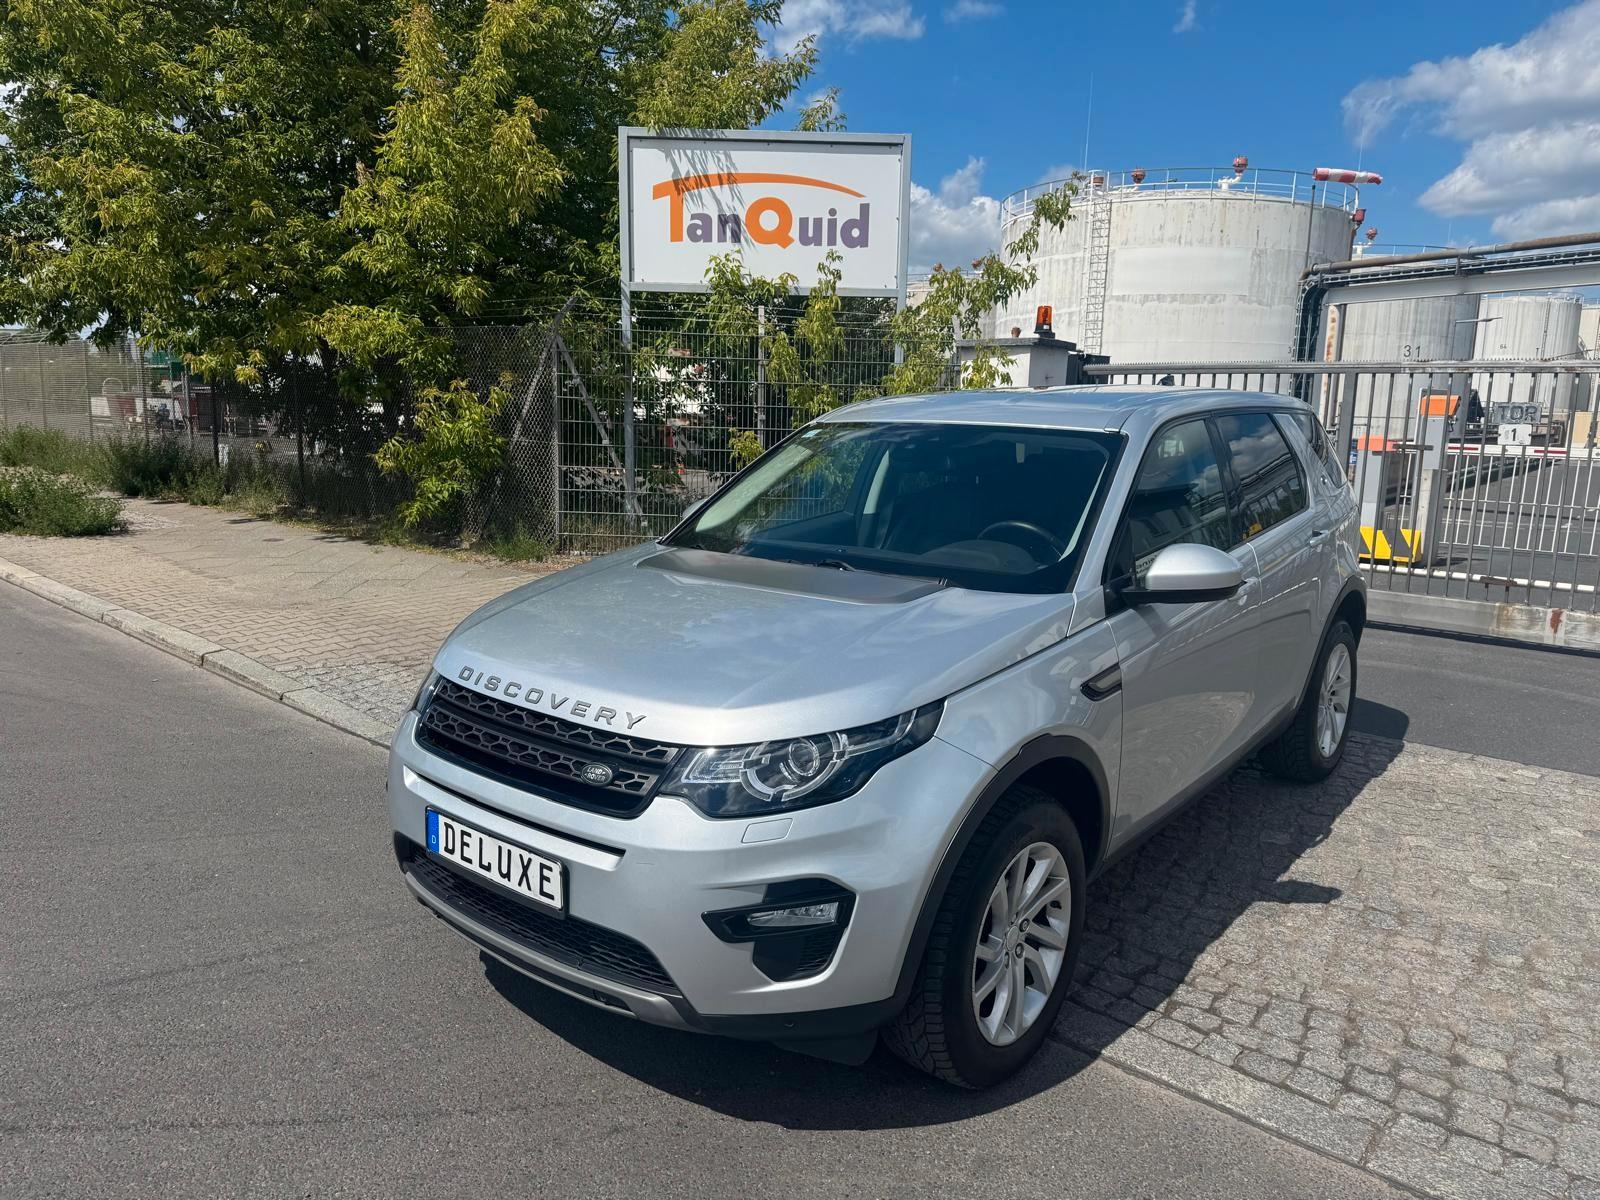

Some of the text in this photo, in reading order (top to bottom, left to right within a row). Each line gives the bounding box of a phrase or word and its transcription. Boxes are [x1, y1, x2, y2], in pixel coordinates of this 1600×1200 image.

[652, 172, 871, 249] TanQuid
[1403, 345, 1421, 358] 31
[1497, 405, 1538, 422] TOR
[458, 665, 647, 730] DISCOVERY
[431, 834, 437, 844] D
[443, 821, 556, 901] DELUXE
